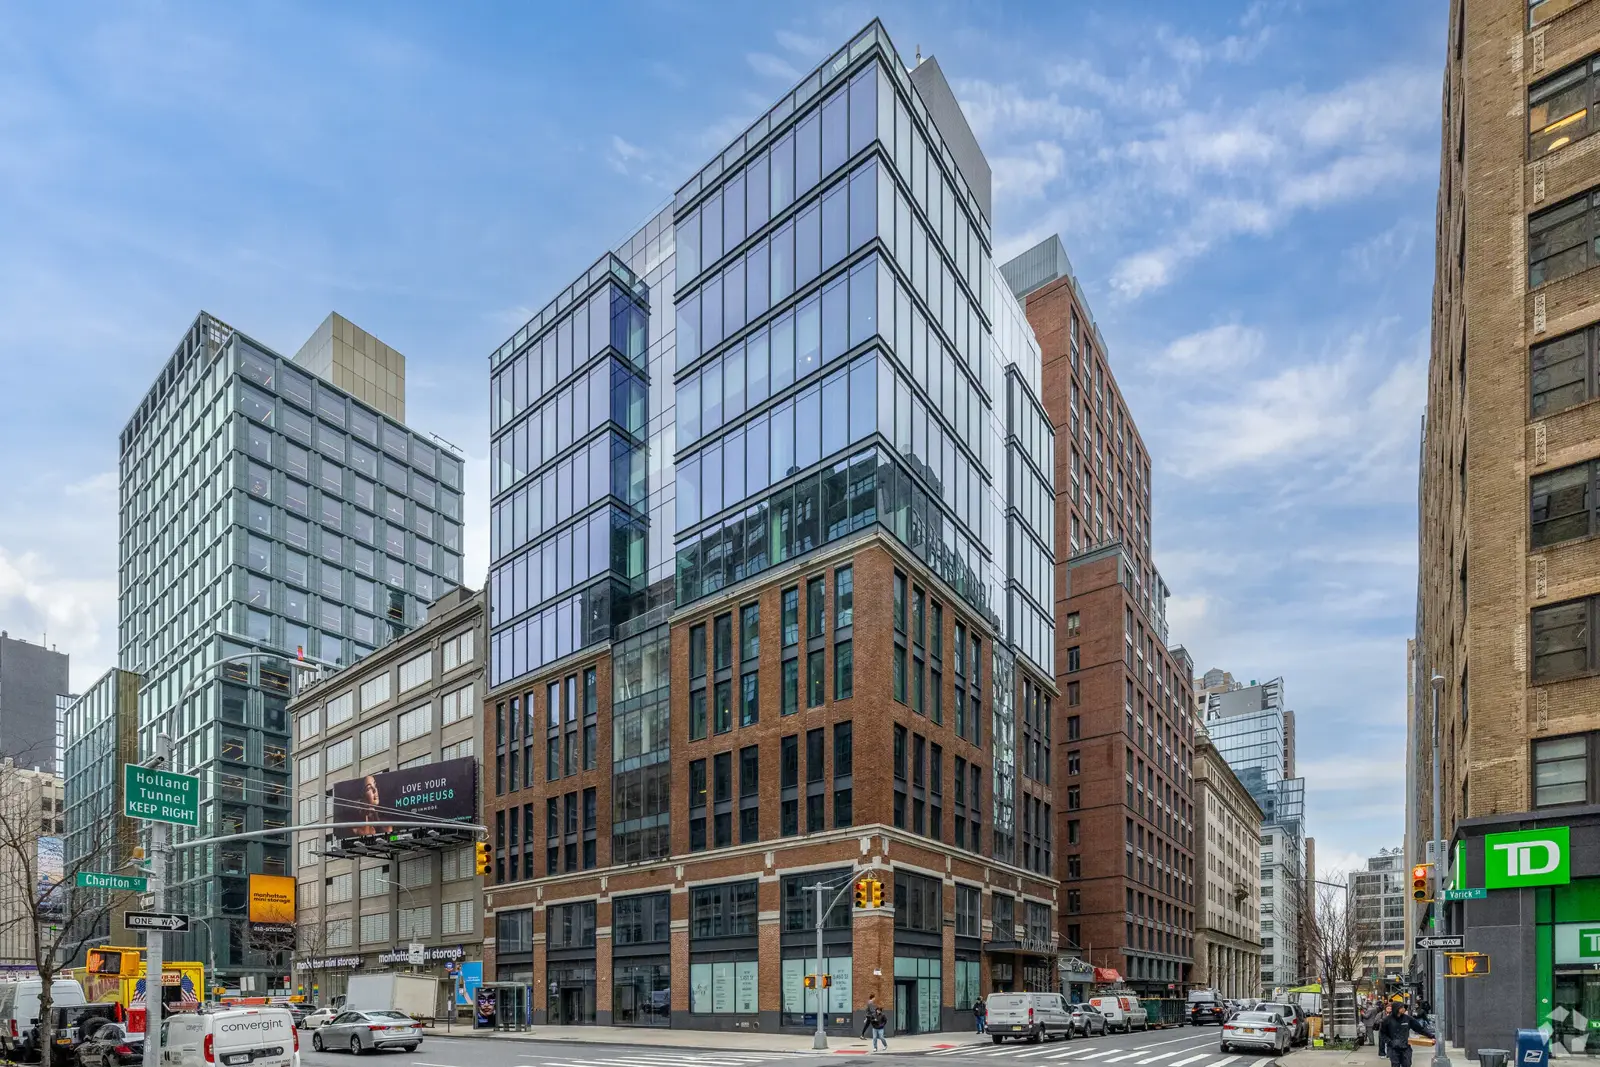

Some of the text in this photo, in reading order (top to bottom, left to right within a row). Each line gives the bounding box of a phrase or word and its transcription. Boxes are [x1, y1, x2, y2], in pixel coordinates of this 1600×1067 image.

[136, 772, 190, 791] Holland
[402, 777, 447, 794] LOVE YOUR
[139, 787, 186, 805] Tunnel
[395, 788, 454, 808] MORPHEUS8
[129, 801, 195, 820] KEEP RIGHT
[1493, 840, 1561, 877] TD
[85, 874, 130, 888] Charlton
[1449, 891, 1473, 899] Varick
[134, 917, 153, 925] ONE
[1583, 933, 1600, 952] T
[337, 956, 359, 968] storage
[432, 949, 462, 961] storage
[221, 1019, 283, 1033] convergint
